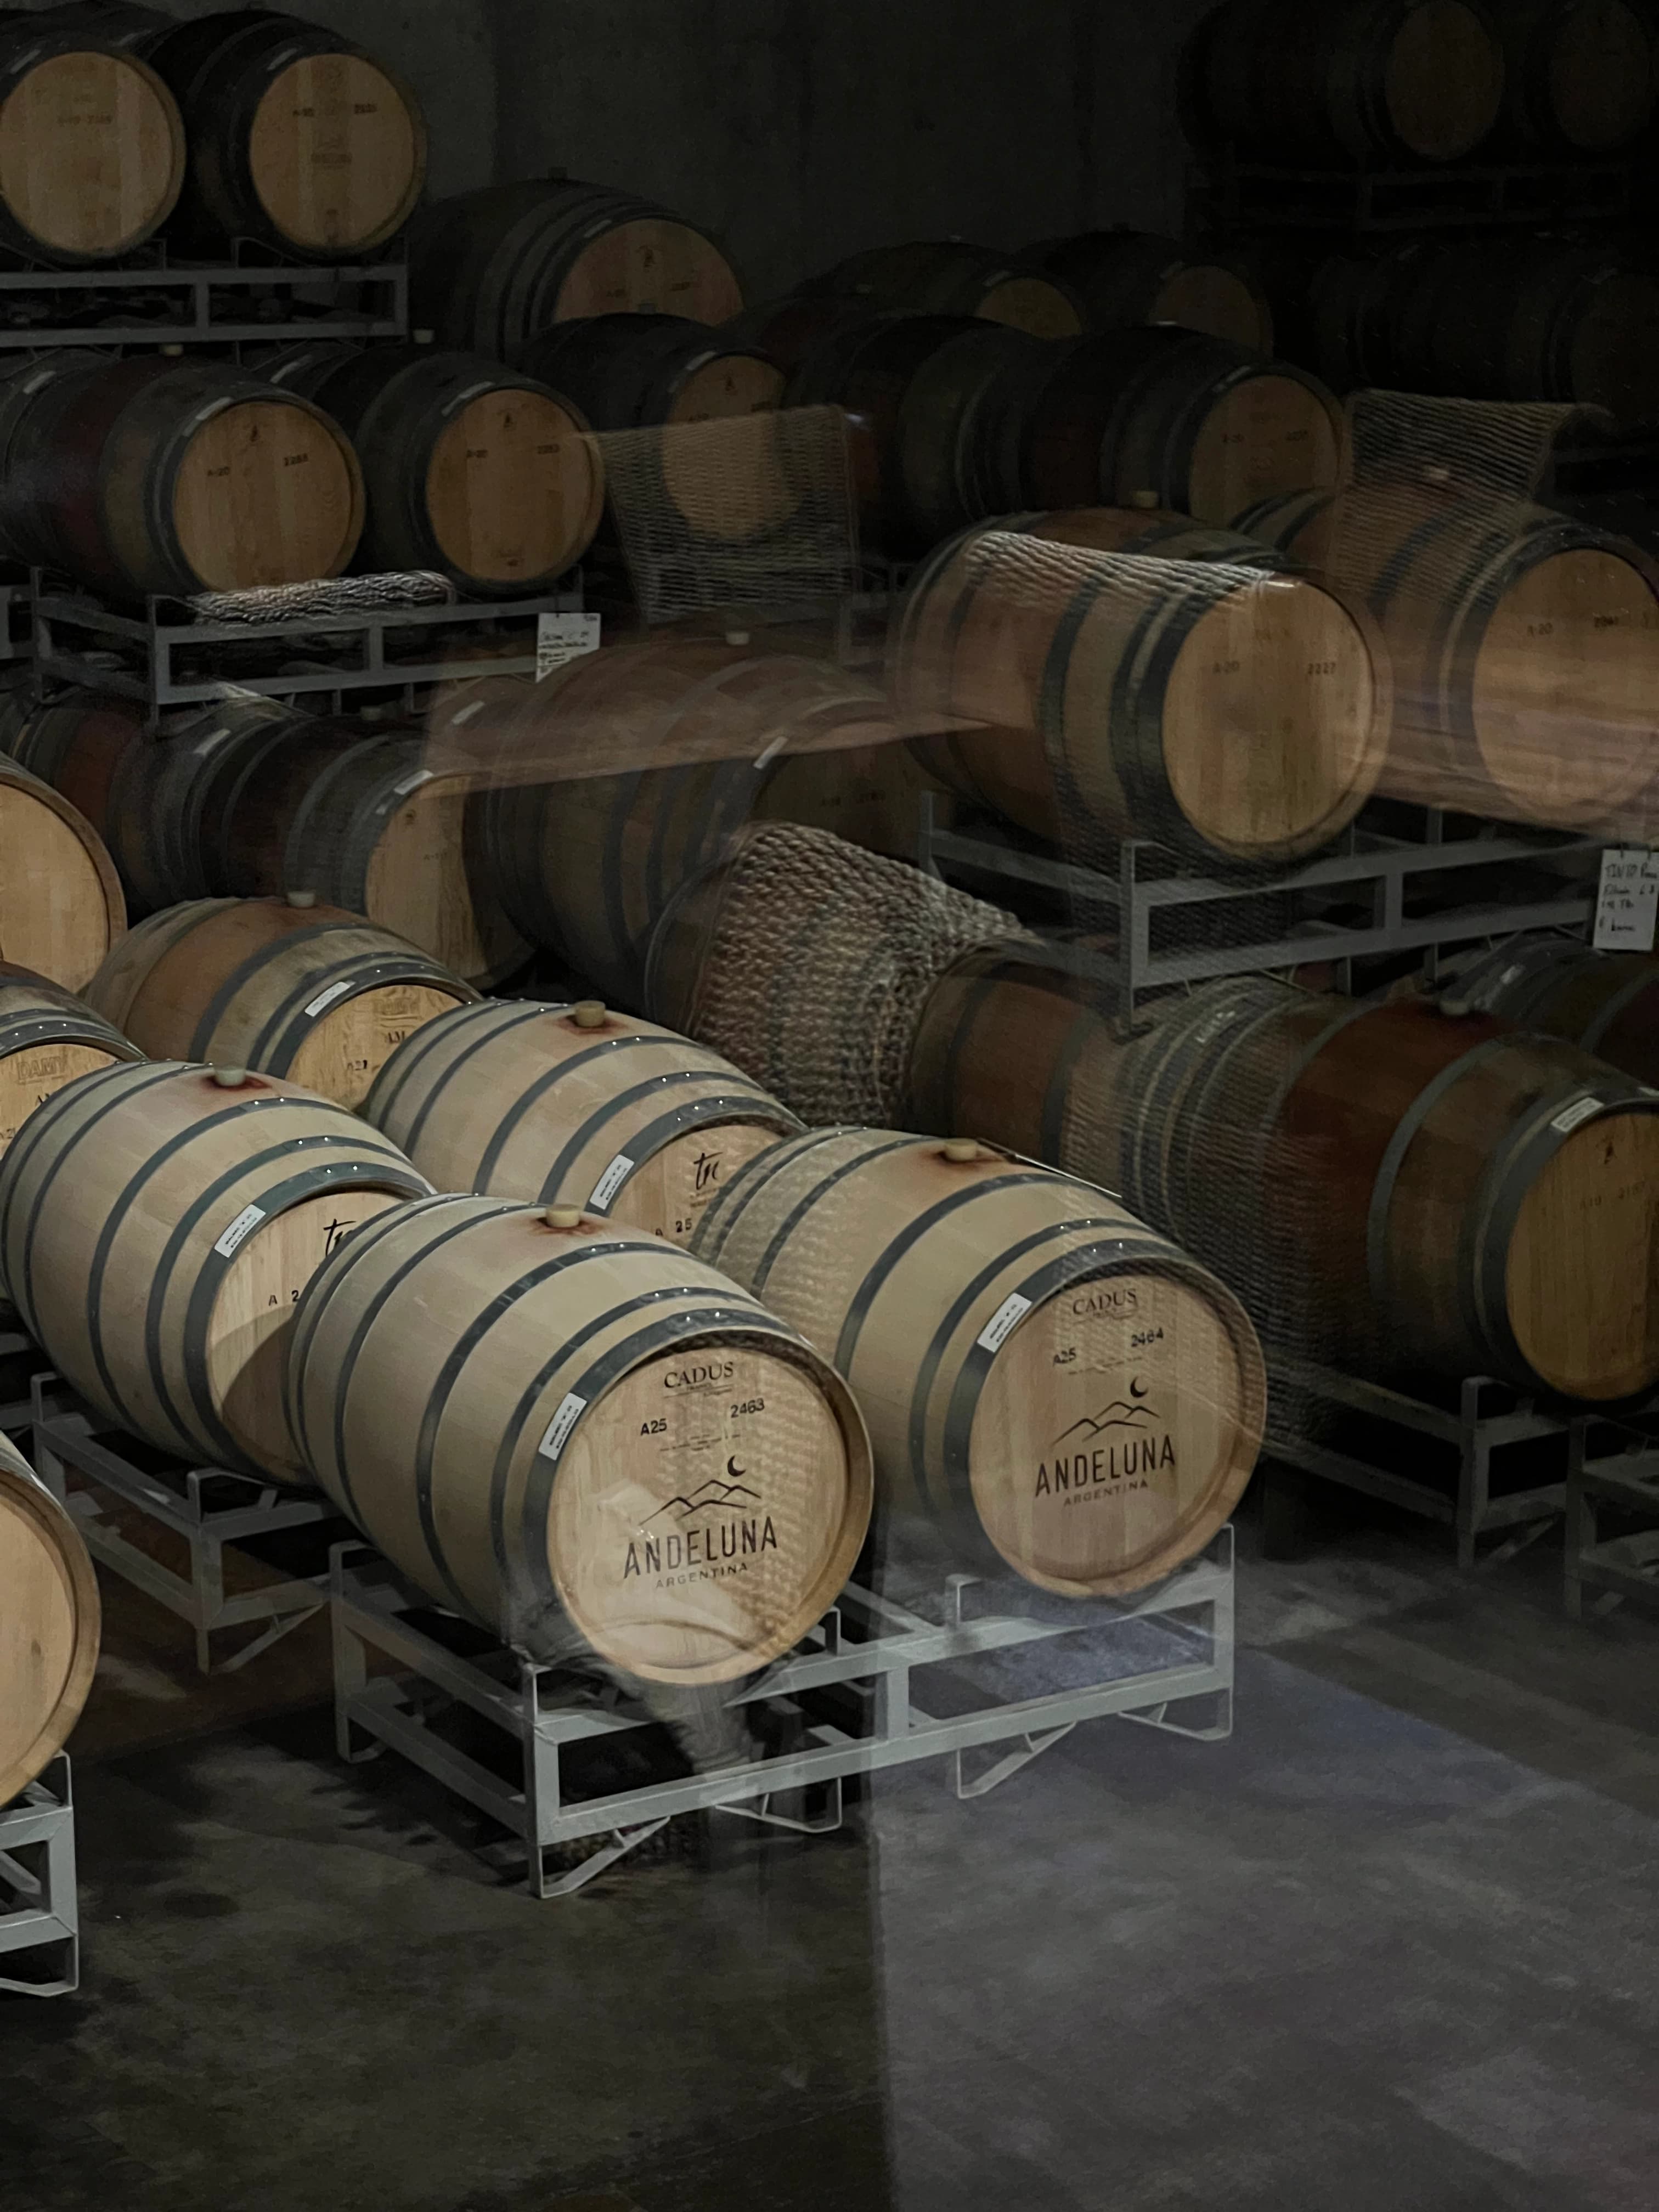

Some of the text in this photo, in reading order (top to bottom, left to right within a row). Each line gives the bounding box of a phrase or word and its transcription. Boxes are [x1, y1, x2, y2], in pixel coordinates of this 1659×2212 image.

[1073, 1288, 1137, 1315] CADUS
[1053, 1327, 1164, 1365] A25 2464
[663, 1361, 733, 1389] CADUS
[640, 1398, 765, 1436] A25 2463
[1035, 1434, 1176, 1498] ANDELUNA
[1064, 1479, 1149, 1508] ARGENTINA
[623, 1516, 778, 1579] ANDELUNA
[656, 1562, 748, 1589] ARGENTINA
